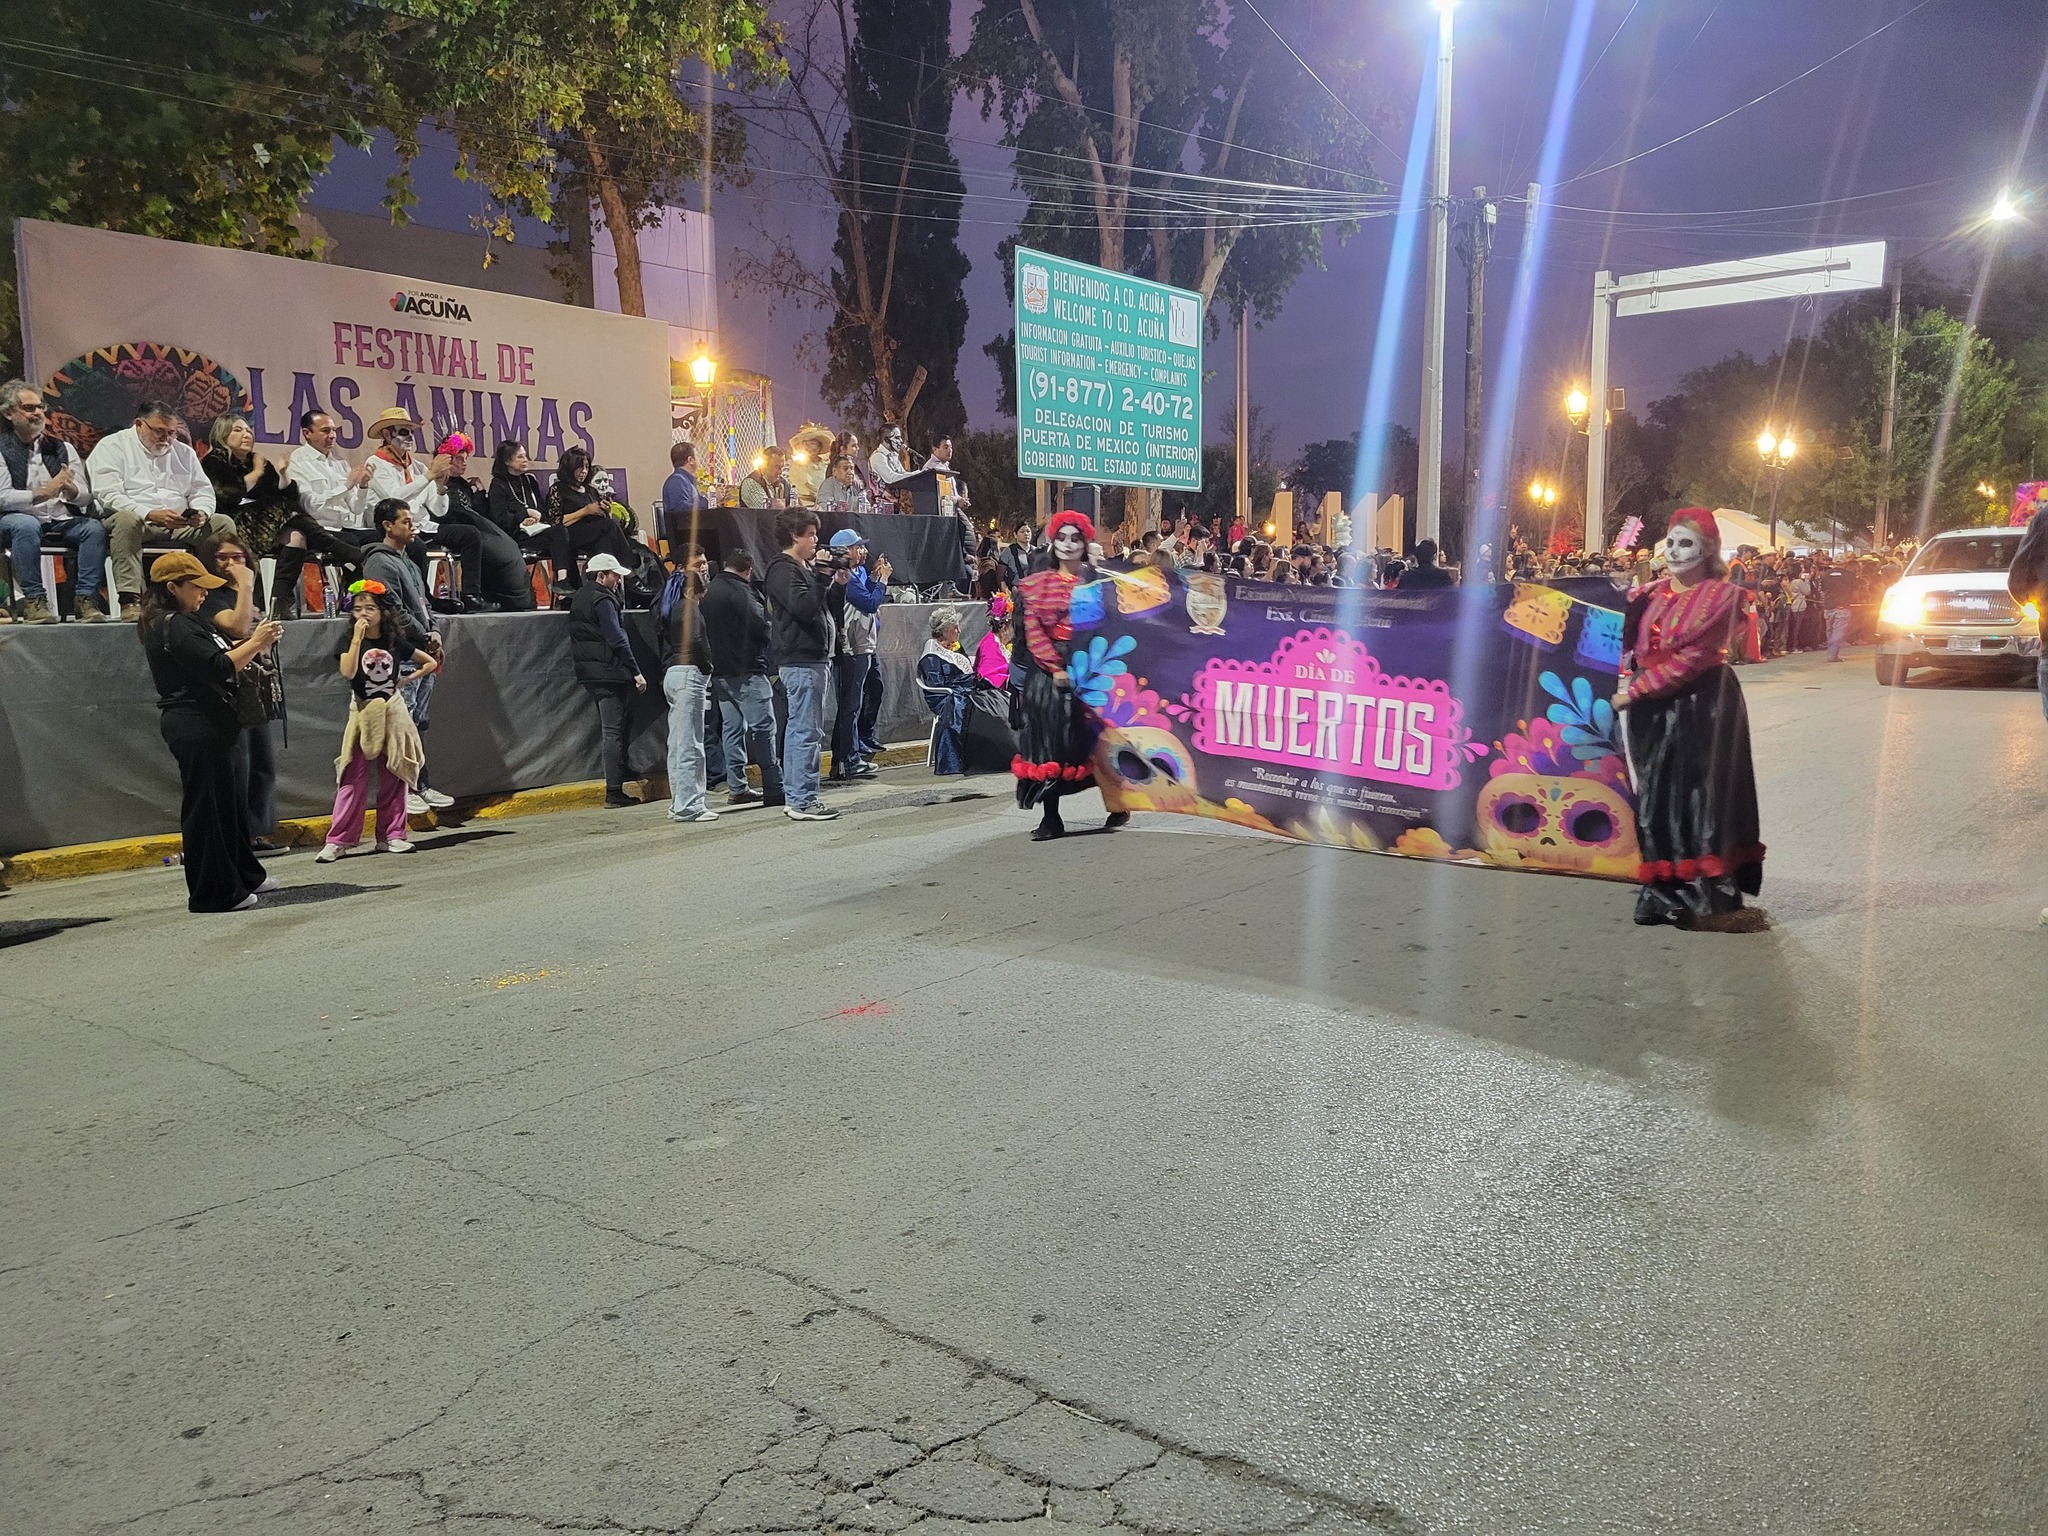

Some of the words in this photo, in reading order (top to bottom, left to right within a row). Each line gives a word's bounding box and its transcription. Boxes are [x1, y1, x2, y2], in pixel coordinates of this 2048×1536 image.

[405, 298, 472, 322] ACUÑA
[1053, 270, 1110, 302] BIENVENIDOS
[1114, 285, 1120, 305] A
[1123, 287, 1136, 309] CD.
[1138, 292, 1165, 316] ACUÑA
[1053, 298, 1097, 327] WELCOME
[1102, 309, 1112, 330] TO
[1117, 311, 1131, 334] CD.
[1137, 317, 1165, 340] ACUÑA
[333, 321, 487, 381] FESTIVAL
[497, 342, 535, 386] DE
[1020, 343, 1048, 363] TOURIST
[1050, 350, 1096, 371] INFORMATION
[1104, 359, 1141, 379] EMERGENCY
[1150, 367, 1187, 387] COMPLAINTS
[1021, 321, 1068, 346] INFORMACION
[1071, 332, 1103, 352] GRATUITA
[1110, 340, 1135, 358] AUXILIO
[1137, 345, 1167, 364] TURISTICO
[1173, 352, 1196, 370] QUEJAS
[247, 366, 364, 449] LAS
[395, 375, 597, 463] ÁNIMAS
[1029, 367, 1113, 412] (91-877)
[1122, 387, 1193, 420] 2-40-72
[1023, 428, 1071, 448] PUERTA
[1076, 434, 1092, 450] DE
[1096, 437, 1140, 455] MEXICO
[1146, 440, 1198, 465] (INTERIOR)
[1035, 408, 1112, 433] DELEGACION
[1119, 420, 1135, 436] DE
[1141, 423, 1189, 442] TURISMO
[1024, 450, 1075, 470] GOBIERNO
[1081, 456, 1099, 472] DEL
[1104, 458, 1138, 476] ESTADO
[1141, 462, 1152, 477] DE
[1155, 463, 1197, 481] COAHUILA
[1330, 668, 1355, 685] DE
[1214, 680, 1436, 776] MUERTOS
